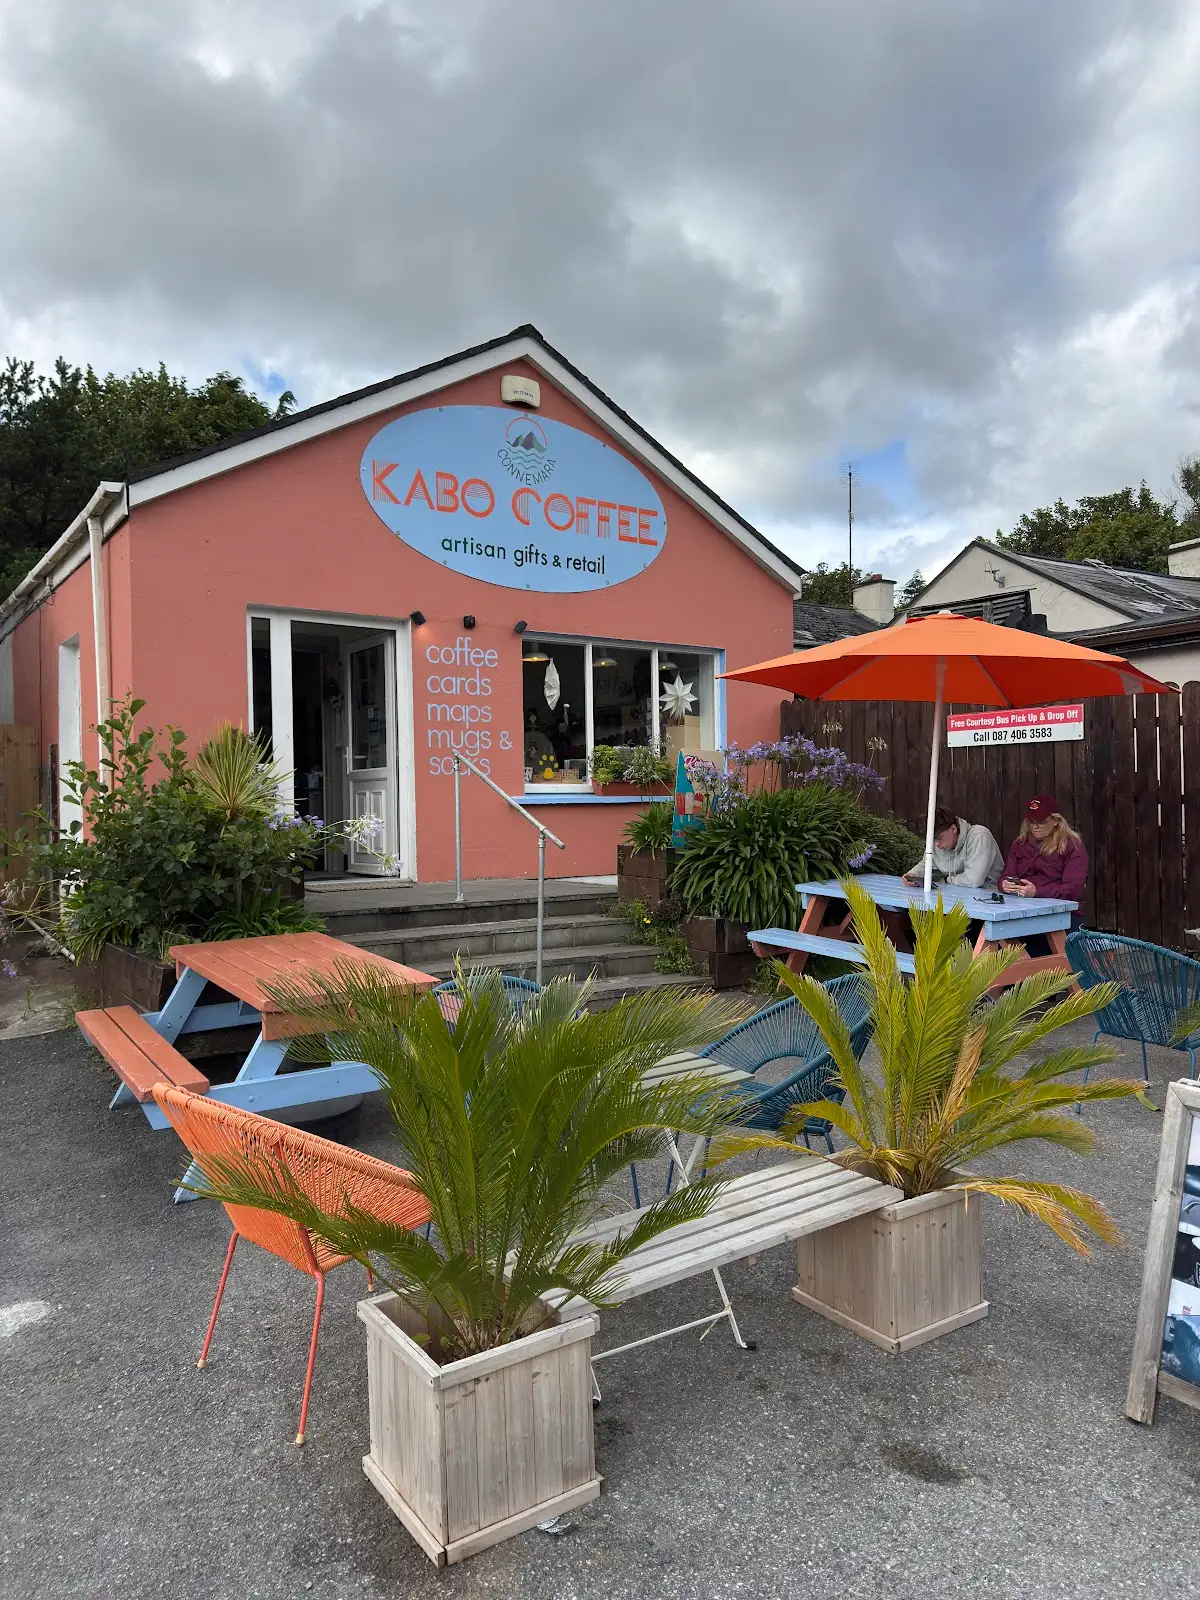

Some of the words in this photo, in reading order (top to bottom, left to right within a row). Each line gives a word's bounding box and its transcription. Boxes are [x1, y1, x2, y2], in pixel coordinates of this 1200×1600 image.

[497, 449, 557, 486] CONNEMARA
[372, 459, 495, 518] KABO
[511, 487, 658, 547] COFFEE
[441, 537, 506, 559] artisan
[513, 543, 548, 567] gifts
[552, 554, 562, 568] &
[566, 555, 605, 574] retail
[425, 636, 499, 668] coffee
[426, 668, 492, 696] cards
[427, 702, 492, 729] maps
[951, 719, 965, 728] Free
[966, 717, 995, 728] Courtesy
[996, 716, 1009, 725] Bus
[1011, 714, 1026, 723] Pick
[1028, 713, 1038, 723] Up
[1039, 712, 1046, 721] &
[1047, 711, 1065, 721] Drop
[1067, 709, 1079, 719] Off
[427, 728, 492, 756] mugs
[499, 730, 513, 750] &
[973, 731, 990, 743] Call
[992, 730, 1008, 741] 087
[1010, 729, 1027, 740] 406
[1029, 727, 1052, 739] 3583
